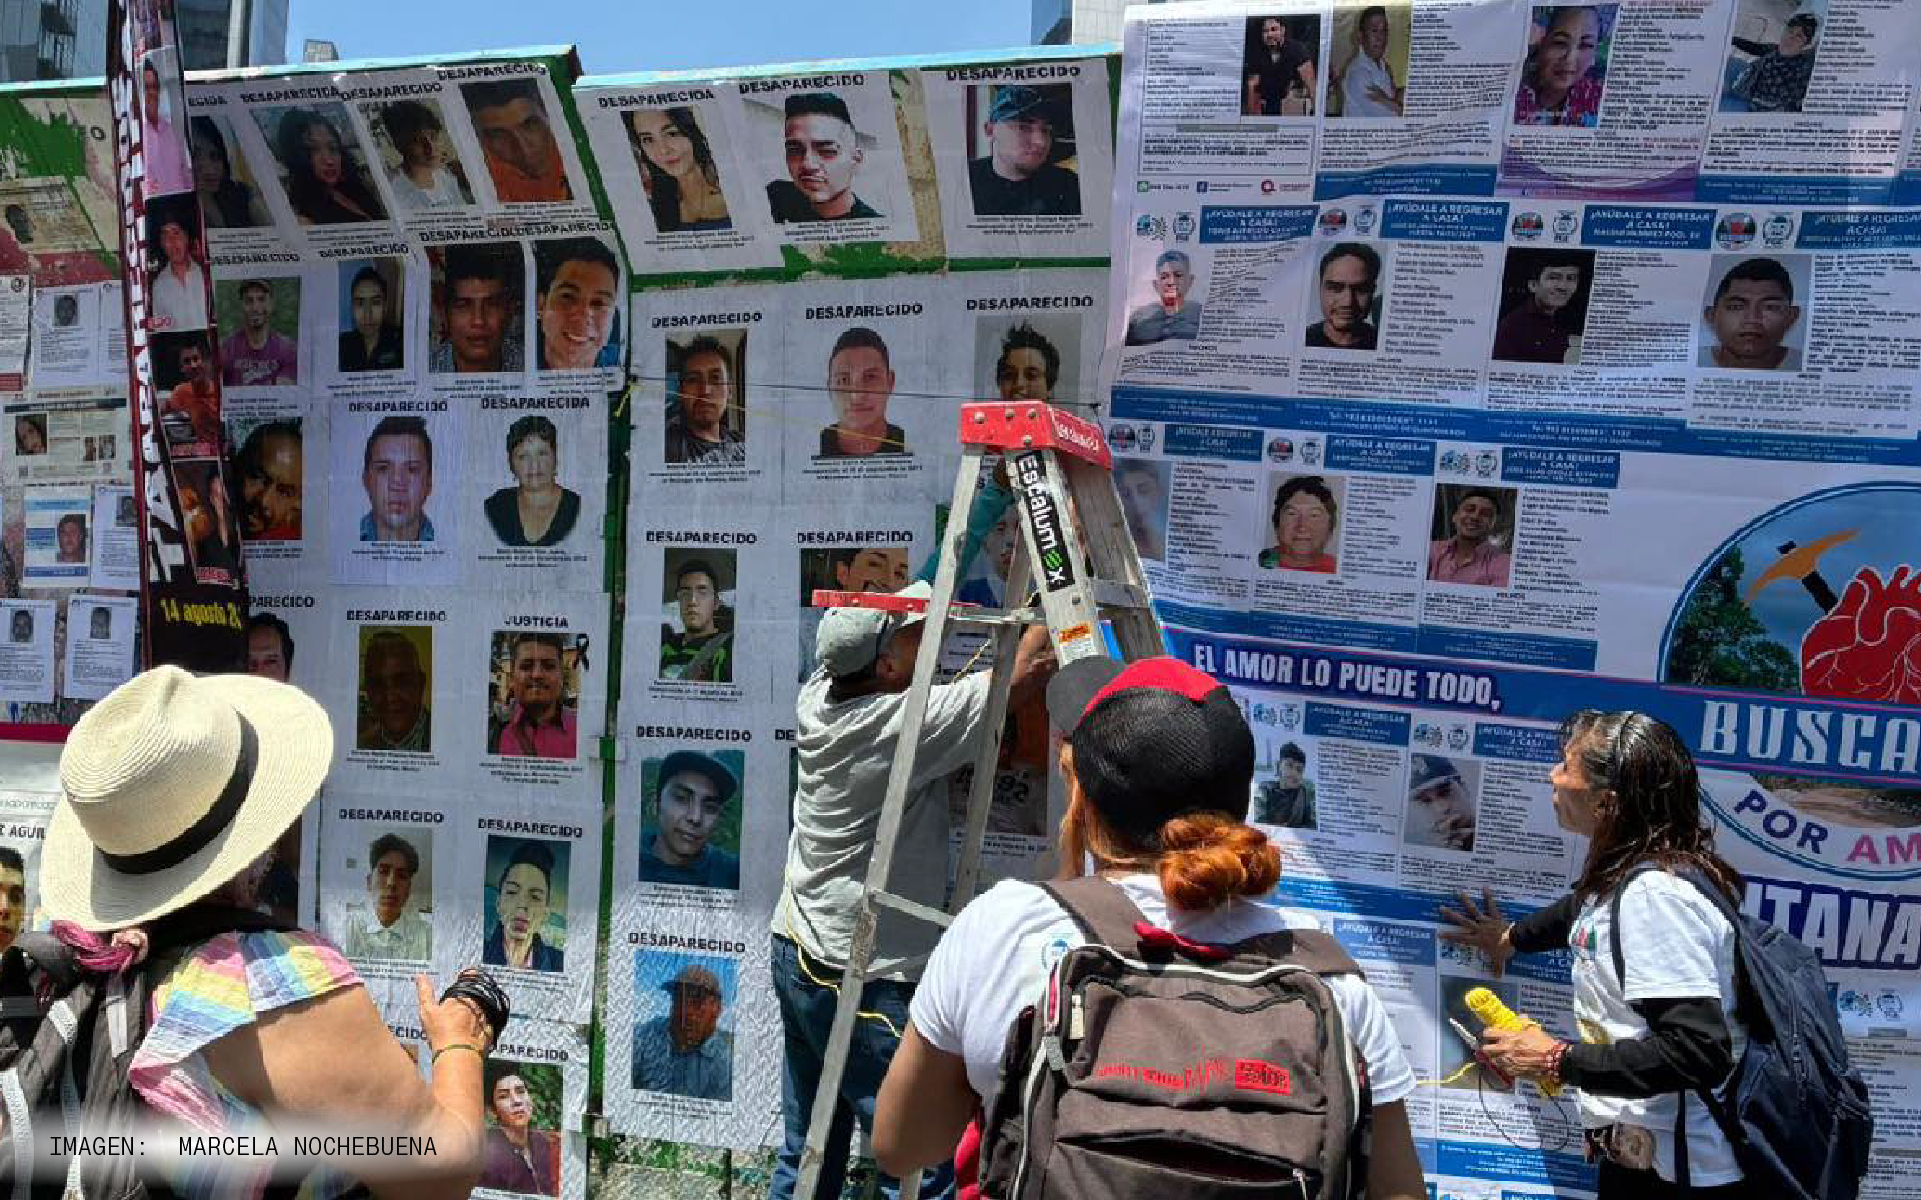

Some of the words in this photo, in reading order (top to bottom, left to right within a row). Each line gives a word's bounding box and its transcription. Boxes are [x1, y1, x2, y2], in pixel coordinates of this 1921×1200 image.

[946, 65, 1081, 82] DESAPARECIDO
[739, 74, 864, 95] DESAPARECIDO
[598, 89, 714, 108] DESAPARECIDA
[805, 302, 923, 320] DESAPARECIDO
[966, 295, 1093, 312] DESAPARECIDO
[651, 311, 762, 329] DESAPARECIDO
[349, 400, 448, 413] DESAPARECIDO
[481, 397, 590, 411] DESAPARECIDA
[646, 531, 757, 545] DESAPARECIDO
[798, 531, 913, 545] DESAPARECIDO
[249, 596, 314, 608] PARECIDO
[346, 610, 448, 622] DESAPARECIDO
[504, 616, 568, 629] JUSTICIA
[1195, 643, 1217, 674] EL
[1225, 650, 1293, 684] AMOR
[1301, 657, 1330, 687] LO
[1339, 661, 1417, 699] PUEDE
[1427, 671, 1501, 711] TODO,
[635, 726, 752, 743] DESAPARECIDO
[339, 808, 444, 824] DESAPARECIDO
[1733, 790, 1828, 854] POR
[477, 818, 583, 838] DESAPARECIDO
[1741, 880, 1921, 966] TANA
[629, 932, 746, 953] DESAPARECIDO
[501, 1045, 569, 1061] PARECIDO
